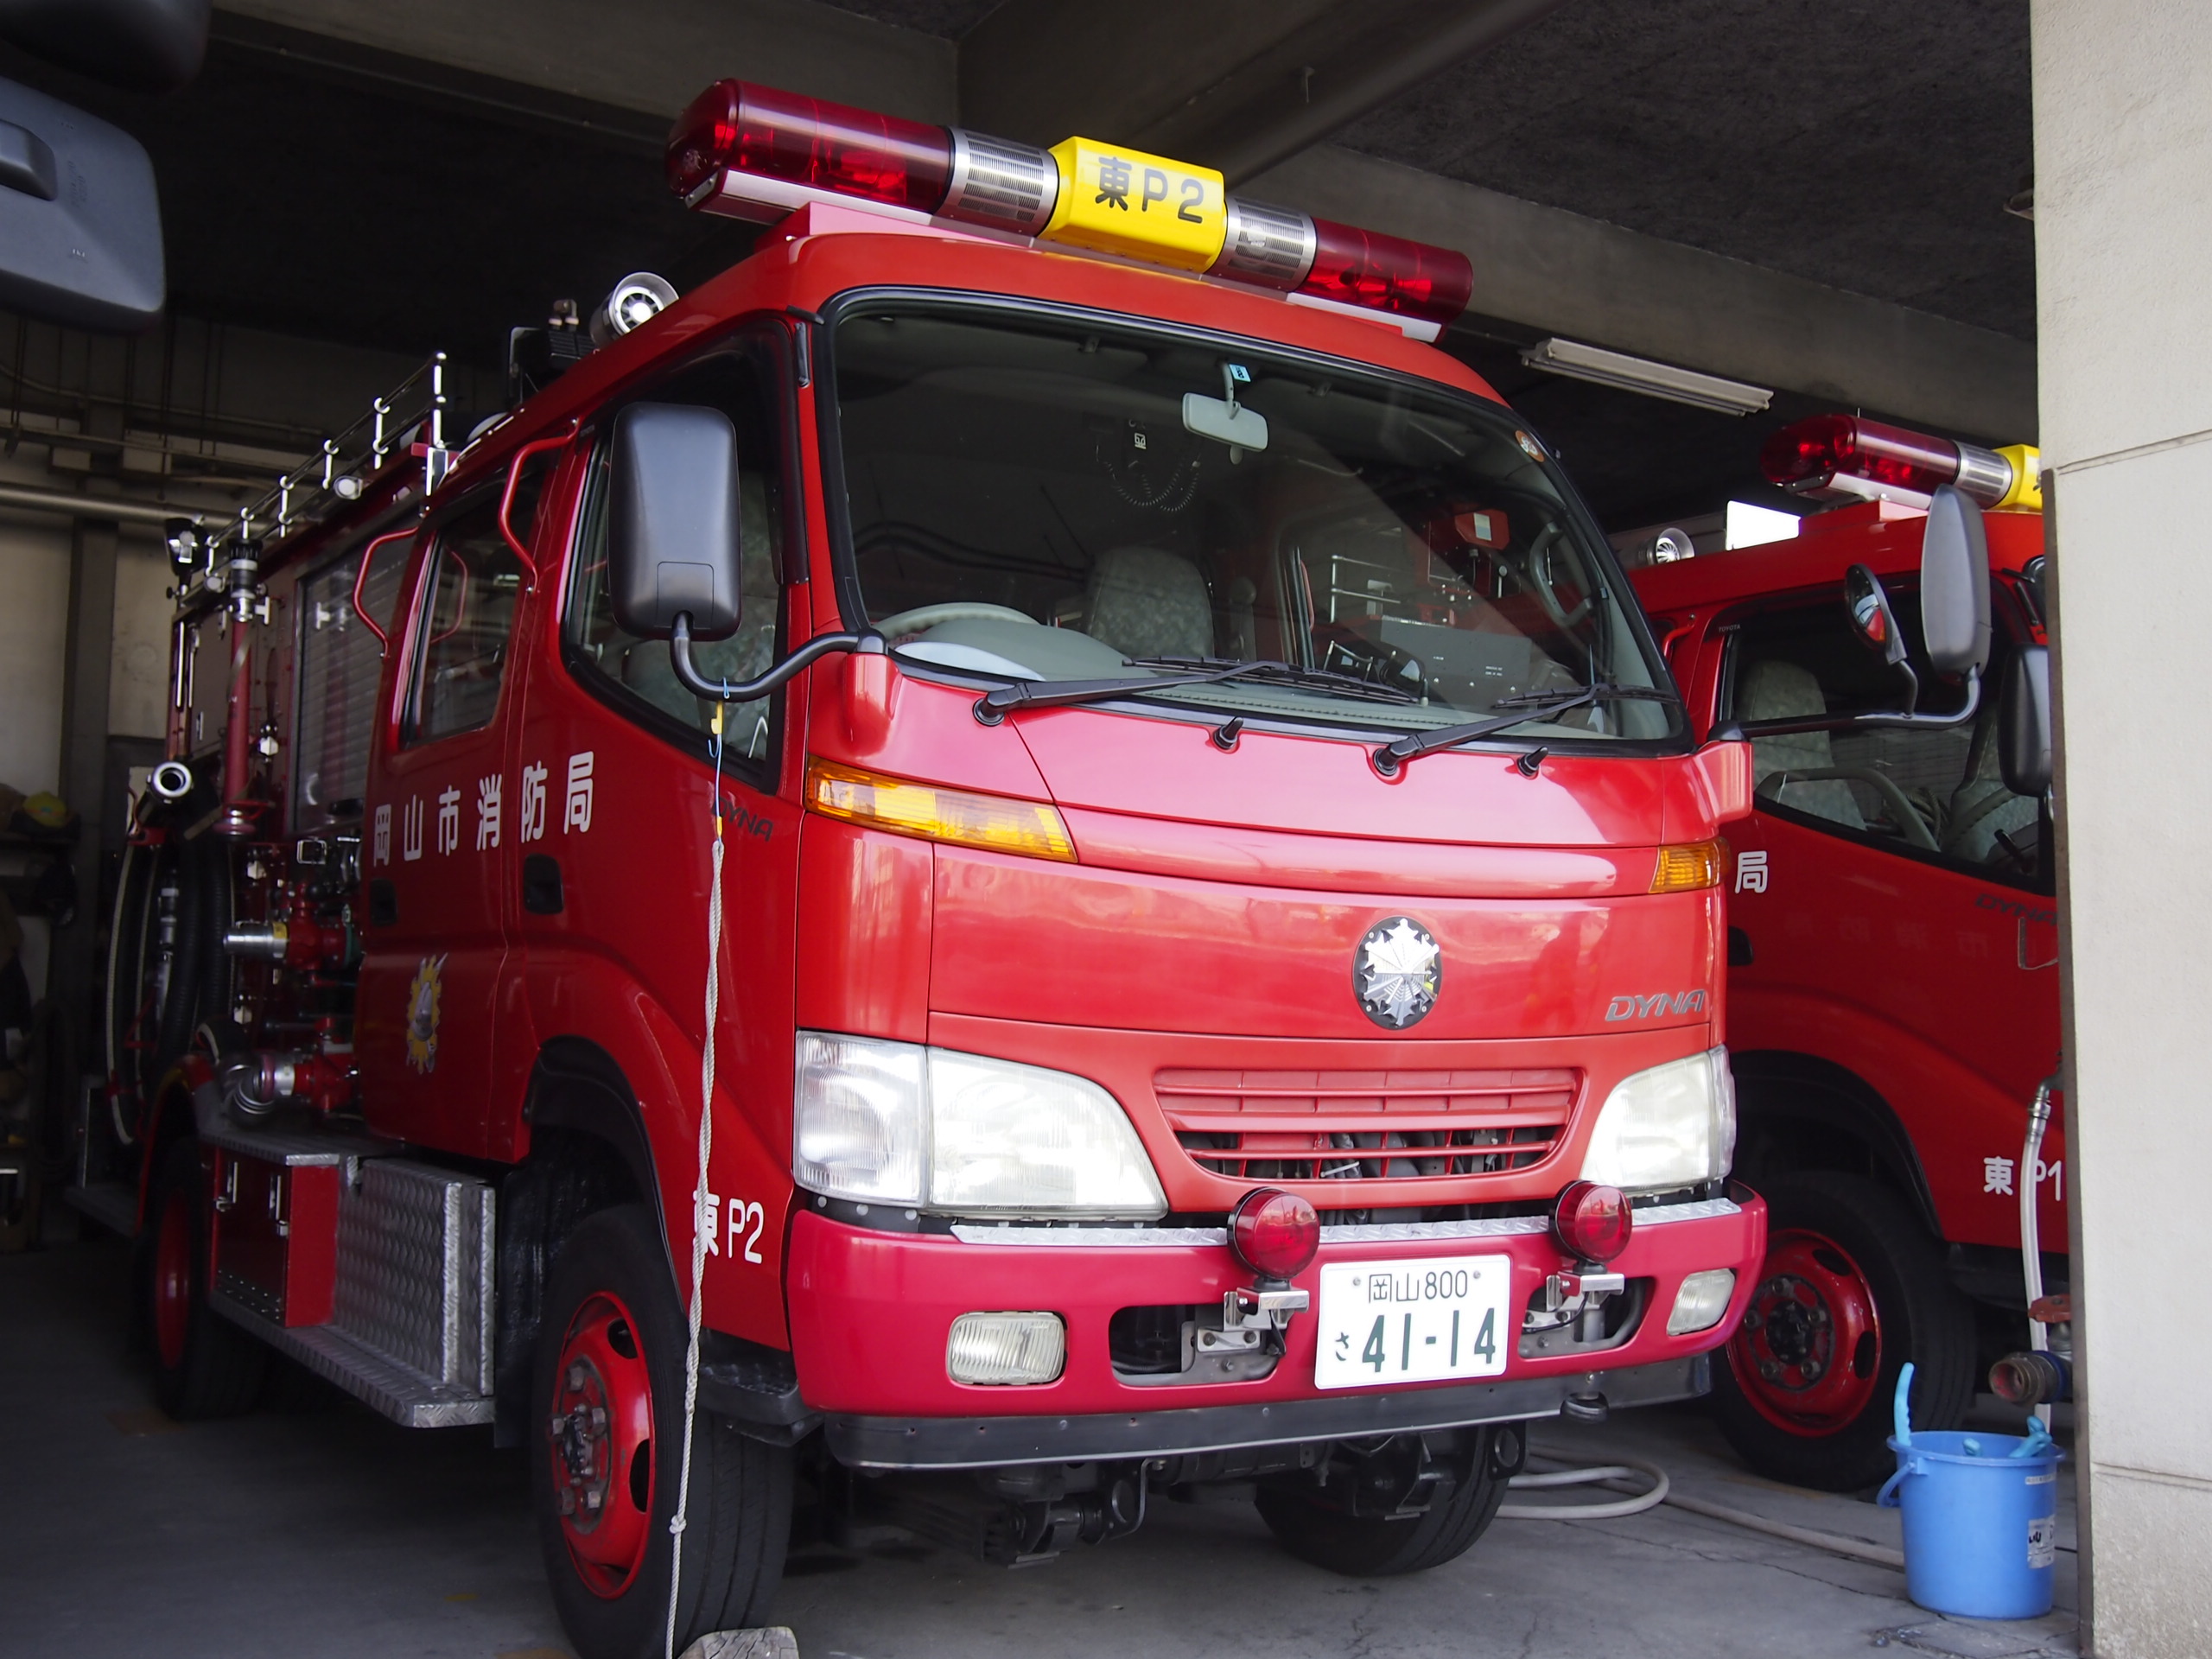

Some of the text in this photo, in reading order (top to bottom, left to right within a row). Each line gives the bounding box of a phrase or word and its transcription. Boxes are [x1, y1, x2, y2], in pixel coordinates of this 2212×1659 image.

[373, 751, 594, 867] 岡山市消防局
[1735, 850, 1768, 893] 局
[1605, 988, 1706, 1022] DYNA
